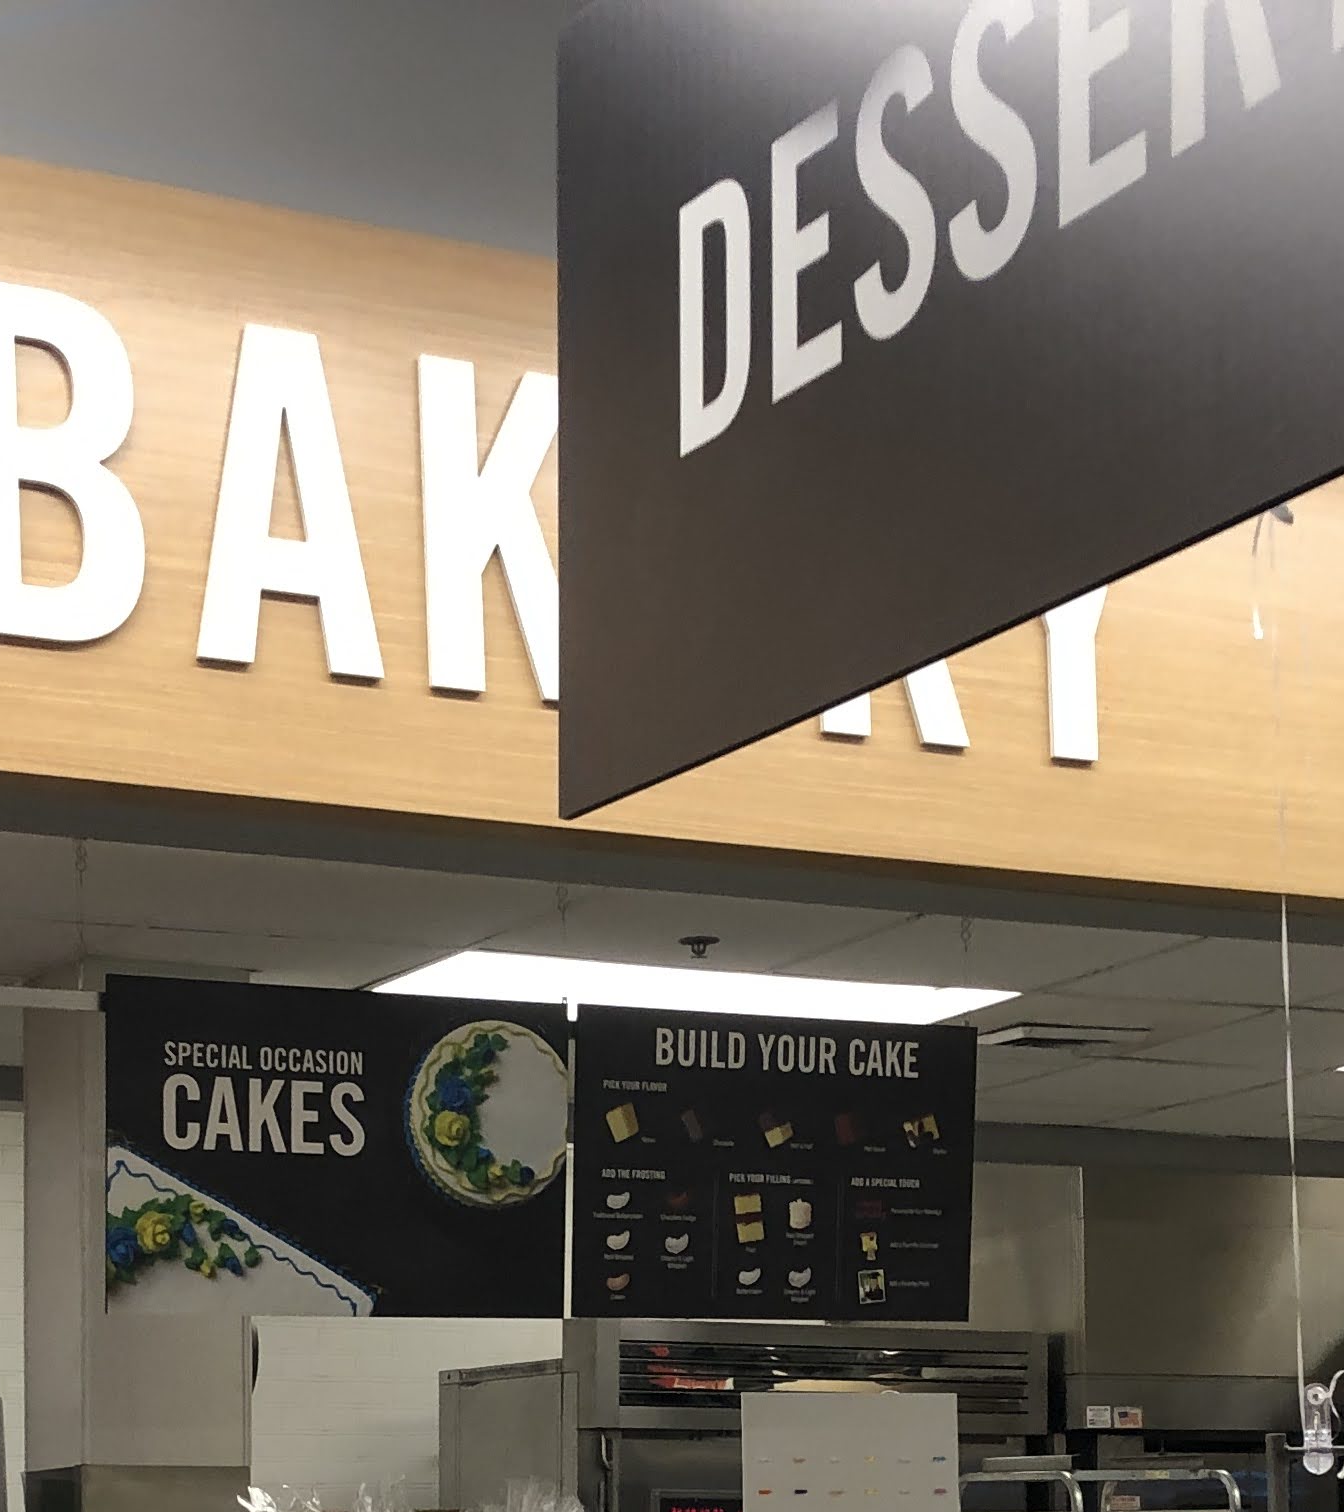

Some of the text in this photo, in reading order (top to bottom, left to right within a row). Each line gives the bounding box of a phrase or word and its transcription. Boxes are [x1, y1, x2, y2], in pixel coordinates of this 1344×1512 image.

[164, 1041, 364, 1076] SPECIAL OCCASION
[656, 1027, 920, 1079] BUILD YOUR CAKE
[162, 1073, 367, 1157] CAKES
